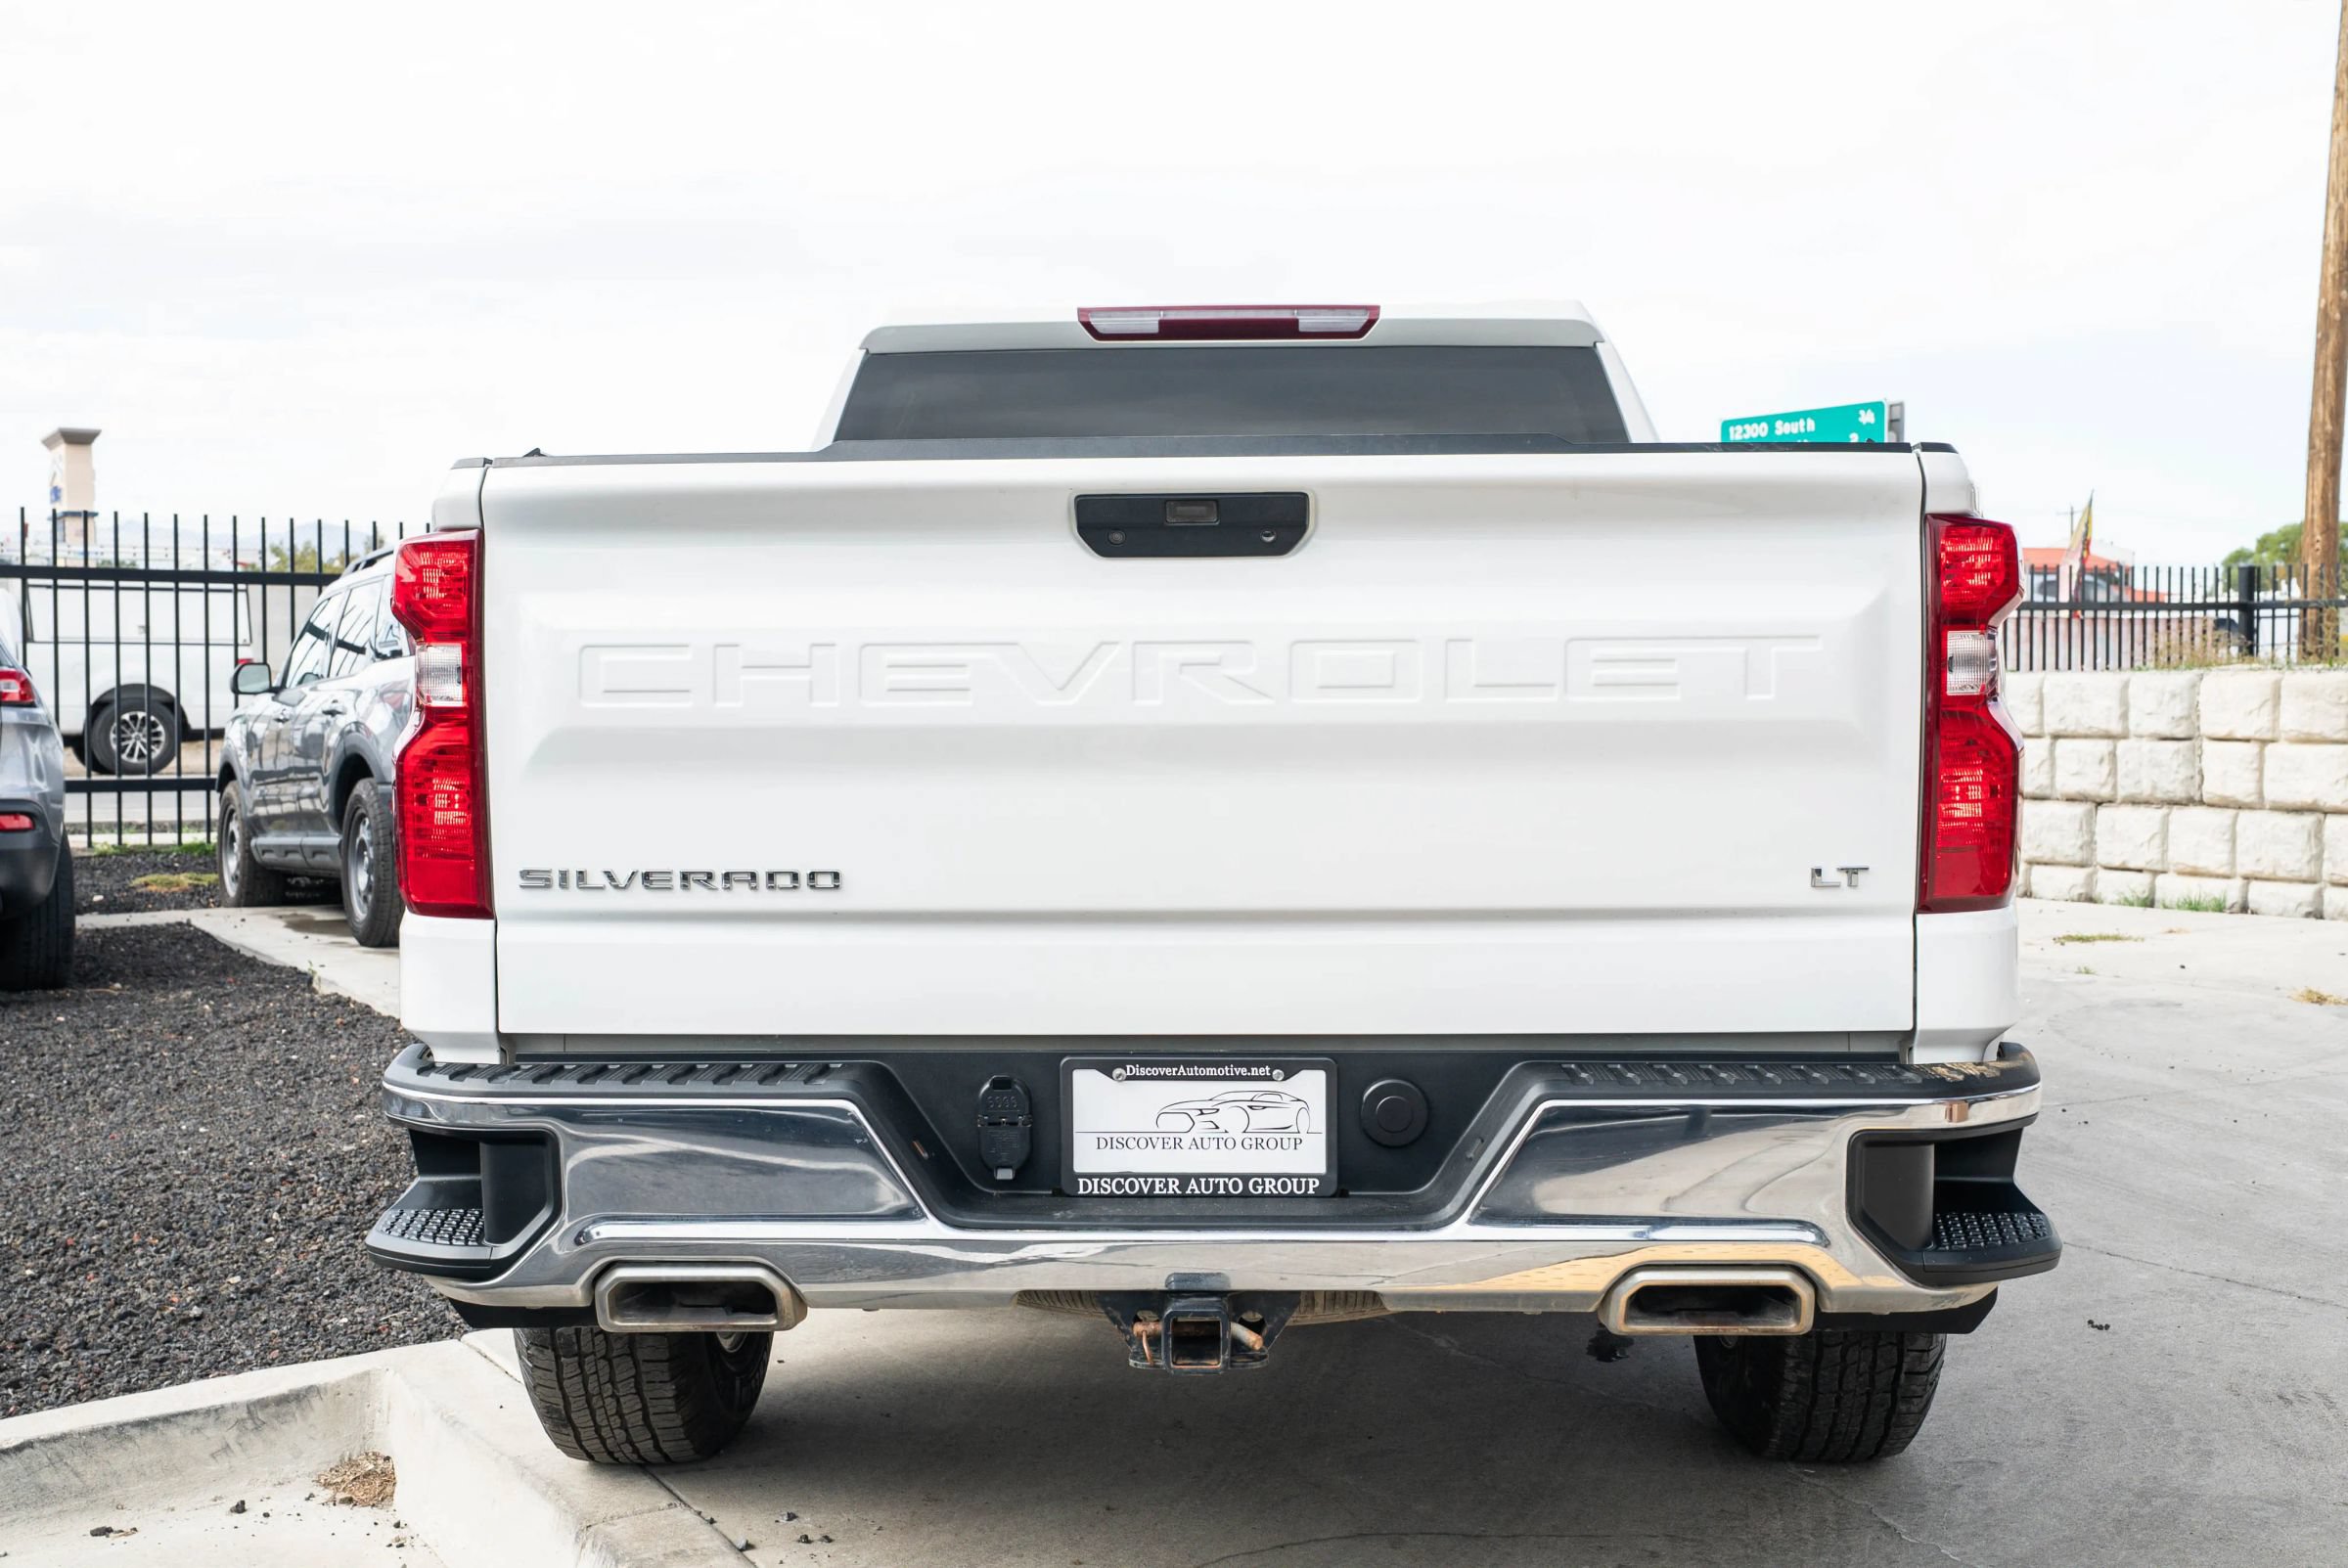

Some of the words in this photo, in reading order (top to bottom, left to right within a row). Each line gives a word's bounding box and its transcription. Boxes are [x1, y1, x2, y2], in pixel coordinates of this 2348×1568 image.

[1729, 423, 1768, 440] 12300
[1775, 418, 1815, 435] South
[578, 635, 1824, 707] CHEVROLET
[519, 869, 843, 890] SILVERADO
[1810, 866, 1870, 887] LT
[1125, 1064, 1271, 1077] DiscoverAutomotive.net
[1096, 1137, 1184, 1150] DISCOVER
[1188, 1137, 1237, 1150] AUTO
[1241, 1137, 1303, 1150] GROUP
[1077, 1178, 1182, 1194] DISCOVER
[1186, 1178, 1243, 1194] AUTO
[1248, 1178, 1320, 1194] GROUP
